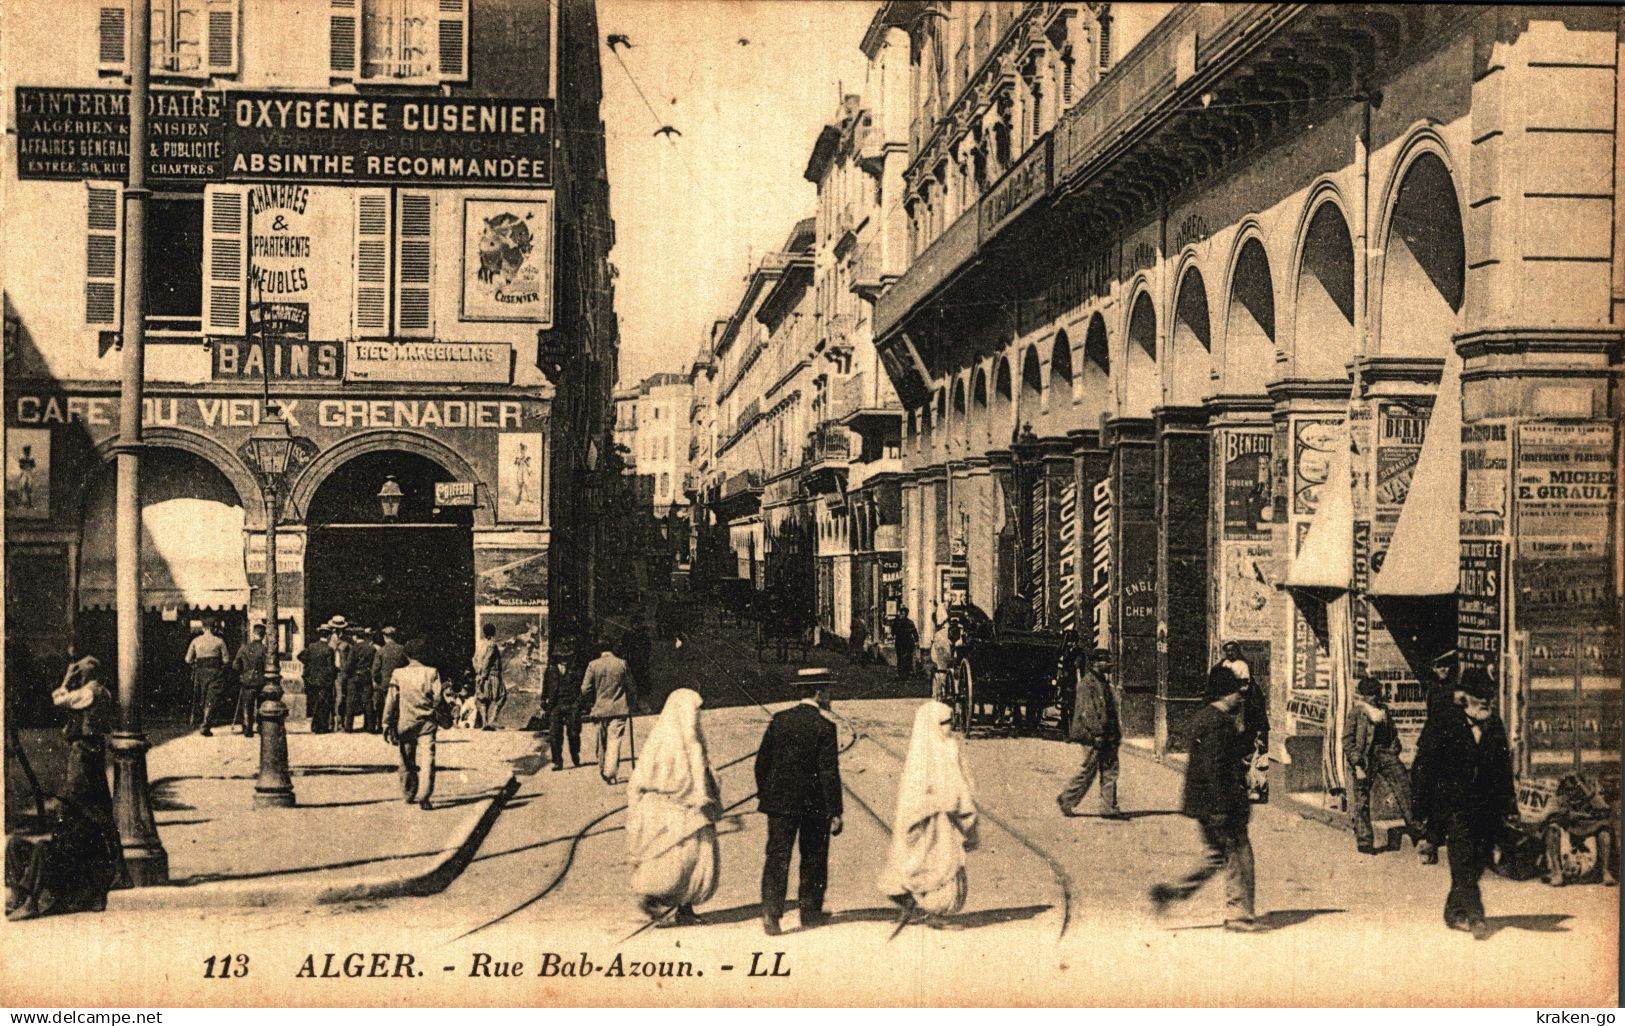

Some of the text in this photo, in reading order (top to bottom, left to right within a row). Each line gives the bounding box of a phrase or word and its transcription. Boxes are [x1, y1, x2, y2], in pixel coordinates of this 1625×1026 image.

[20, 92, 220, 117] L'INTERMDIAIRE
[235, 98, 546, 134] OXYGÉNÉE CUSENIER
[148, 121, 209, 135] NISIEN
[20, 138, 75, 155] AFFAIRES
[104, 162, 127, 173] RUE
[232, 153, 546, 179] ABSINTHE RECOMMANDÉE
[250, 185, 309, 215] CHAMBRES
[272, 215, 289, 231] &
[252, 235, 310, 257] PPARTEMENTS
[218, 343, 337, 378] BAINS
[318, 400, 523, 428] GRENADIER
[1549, 470, 1618, 485] MICHEL
[1537, 486, 1618, 499] GIRAULT
[1125, 605, 1157, 617] CHEMI
